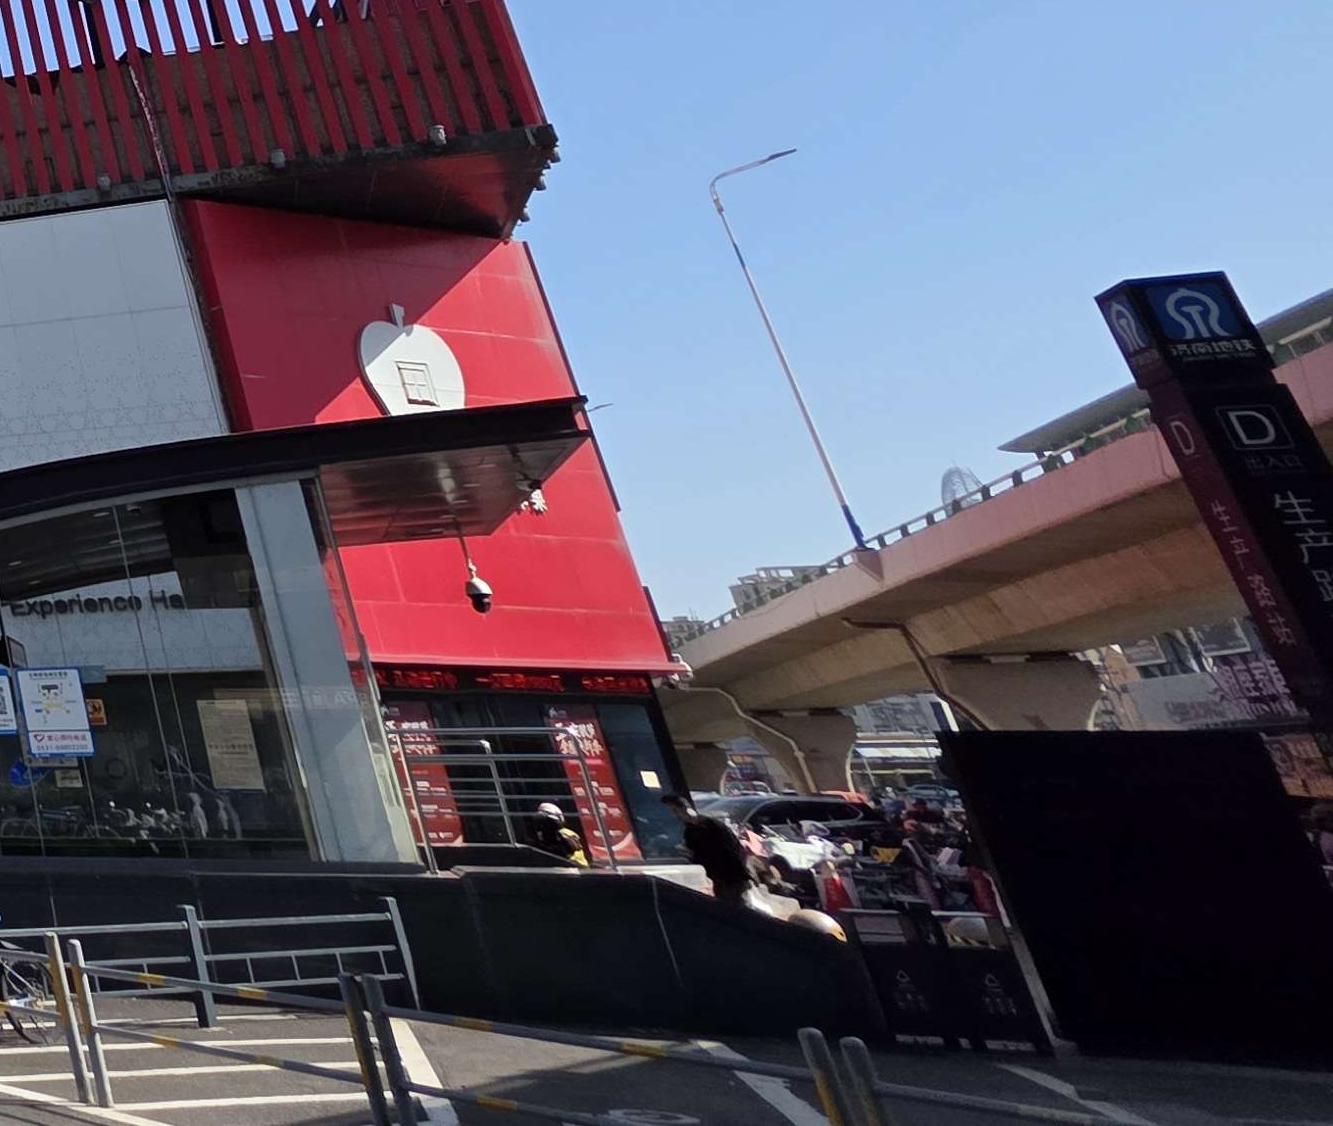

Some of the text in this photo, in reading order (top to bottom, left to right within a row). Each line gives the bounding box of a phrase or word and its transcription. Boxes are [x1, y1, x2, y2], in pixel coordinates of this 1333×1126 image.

[1170, 339, 1257, 356] 济南地铁
[1170, 421, 1196, 455] D
[1228, 411, 1276, 445] D
[1244, 454, 1303, 469] 出入口
